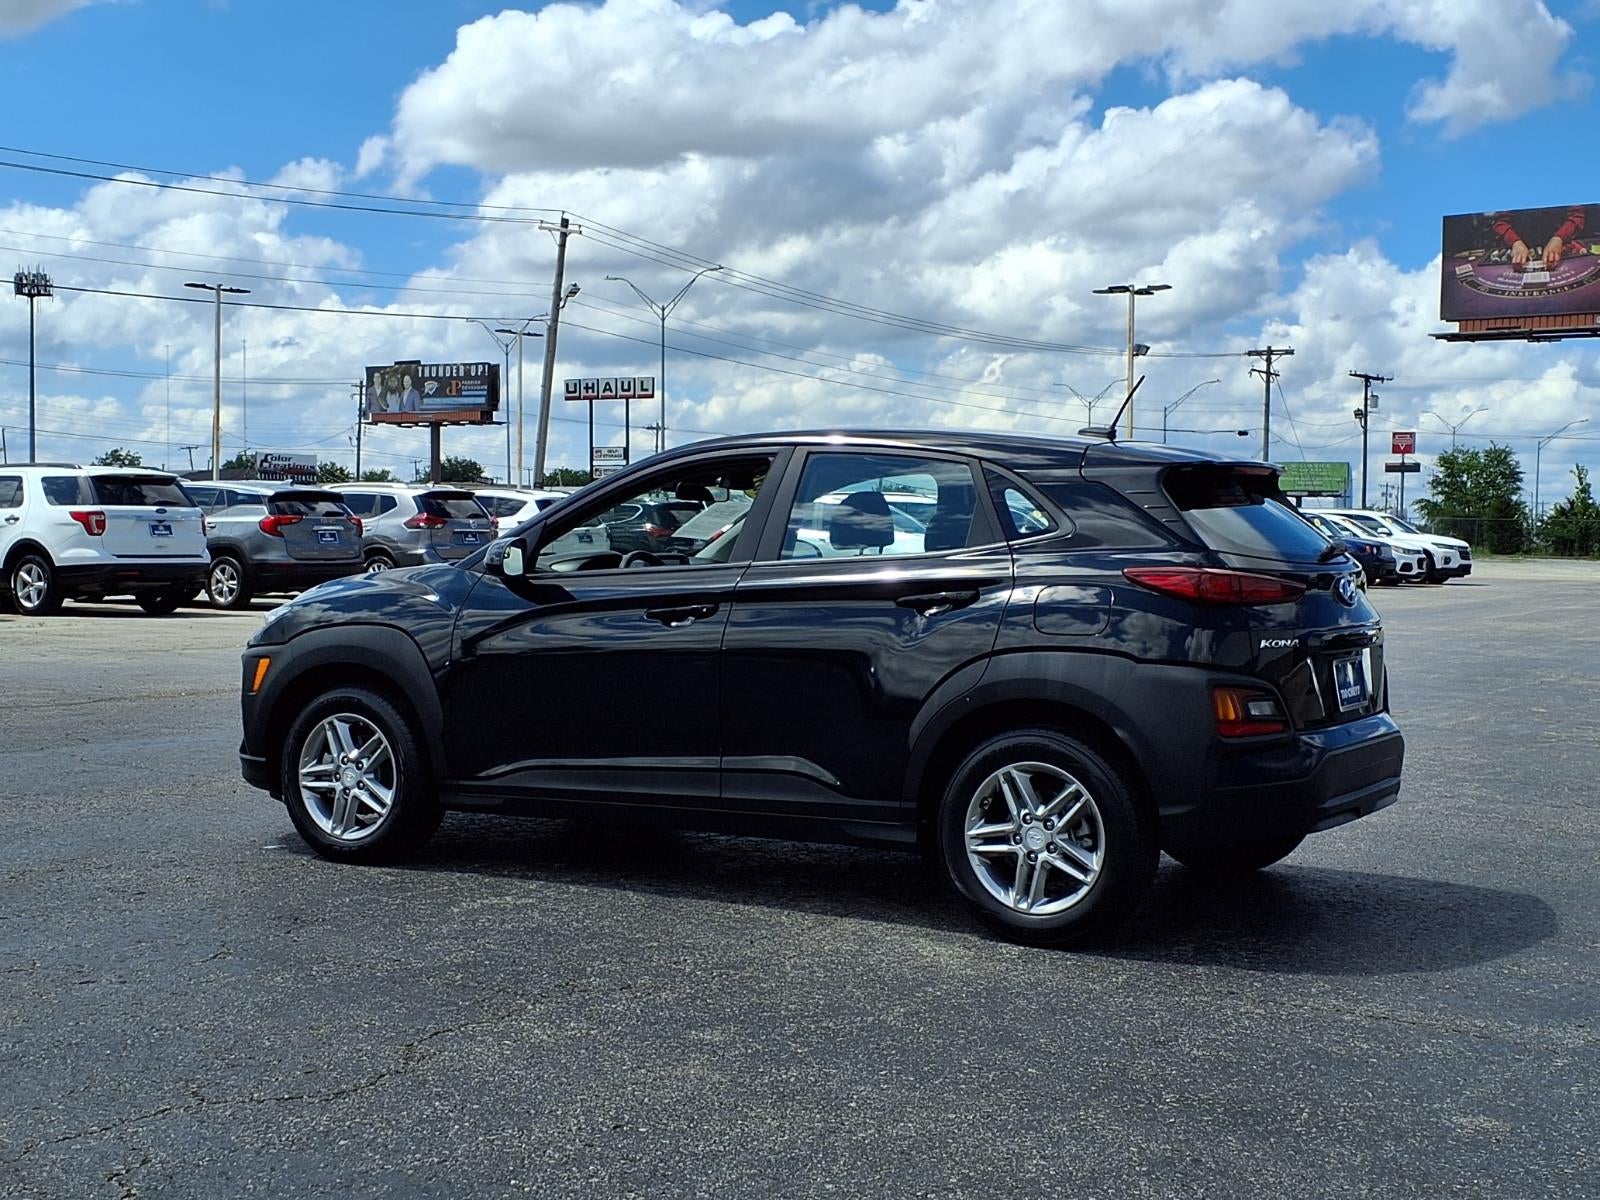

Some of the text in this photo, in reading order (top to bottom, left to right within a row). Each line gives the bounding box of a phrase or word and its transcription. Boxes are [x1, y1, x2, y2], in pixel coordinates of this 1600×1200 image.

[418, 364, 489, 378] THUNDER UP!
[263, 453, 293, 463] Color
[259, 459, 317, 471] Creations
[1259, 639, 1300, 649] KONA
